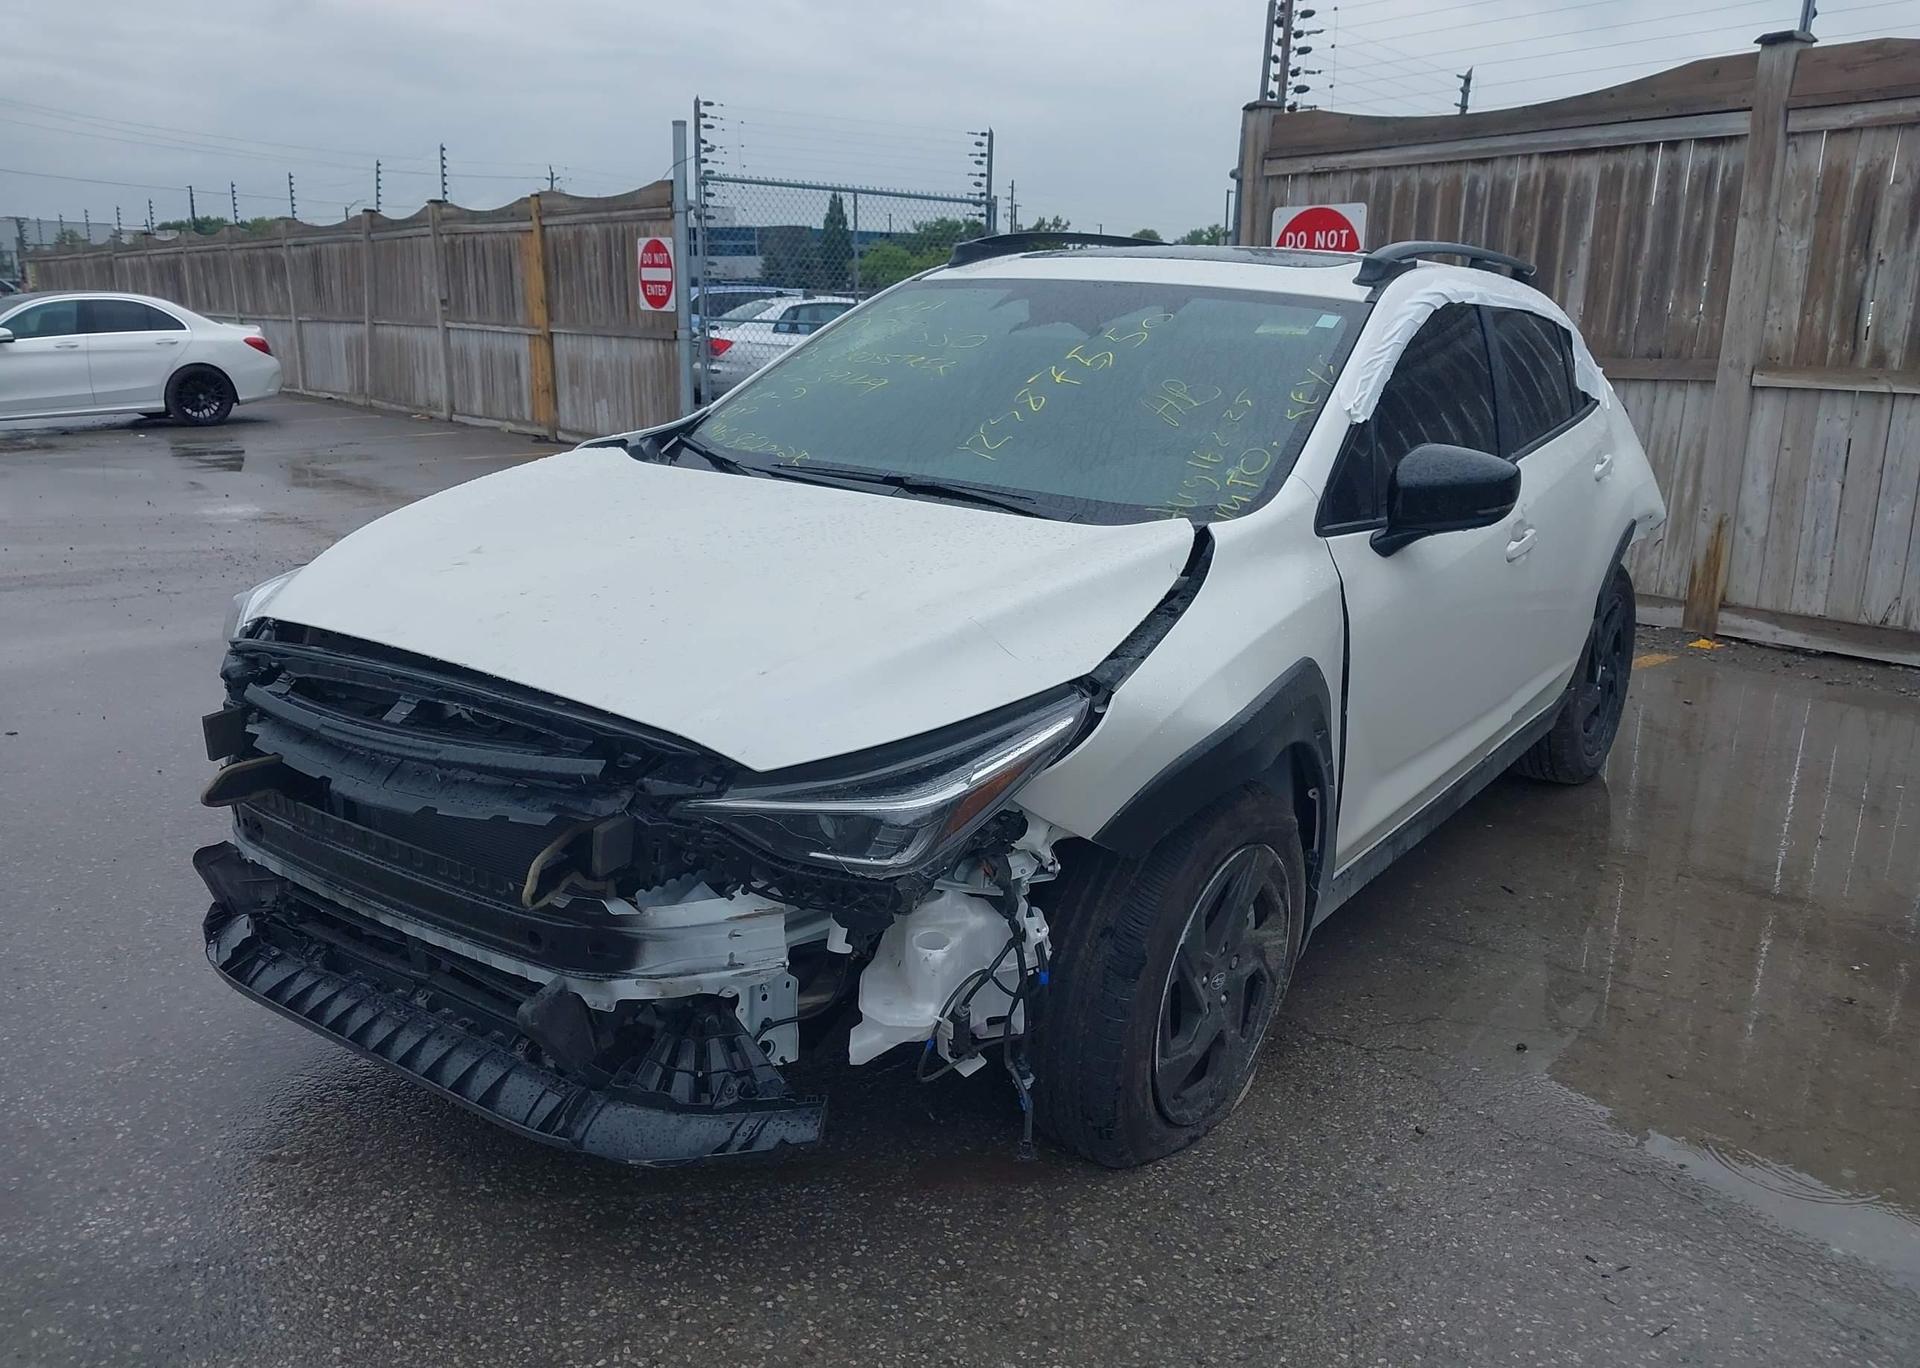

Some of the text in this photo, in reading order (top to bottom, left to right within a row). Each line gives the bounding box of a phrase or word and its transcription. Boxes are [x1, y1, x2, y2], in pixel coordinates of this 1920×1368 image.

[1285, 229, 1349, 249] DO NOT
[642, 252, 668, 265] DO NOT
[646, 284, 667, 296] ENTER
